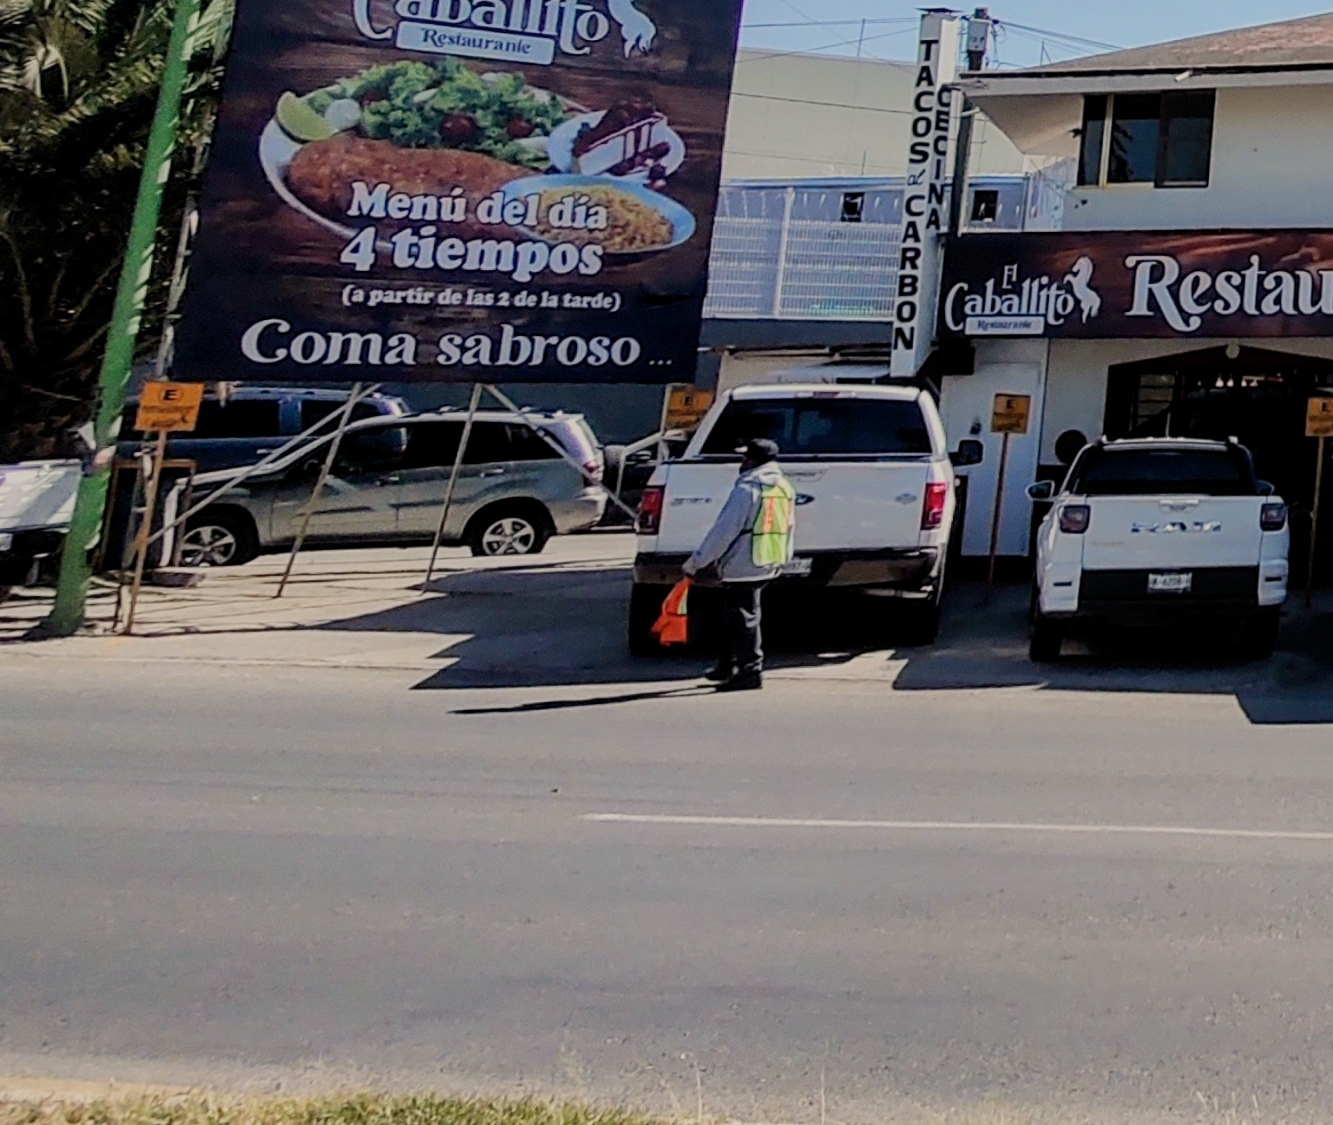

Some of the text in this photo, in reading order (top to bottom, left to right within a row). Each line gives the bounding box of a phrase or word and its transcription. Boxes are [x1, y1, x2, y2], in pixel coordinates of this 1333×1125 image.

[420, 27, 531, 54] Restaurante
[909, 39, 938, 164] TACOS
[926, 84, 951, 231] CECINA
[347, 181, 607, 230] Menú del día
[340, 226, 604, 283] 4 tiempos
[893, 194, 926, 351] CARBON
[342, 285, 621, 312] (a partir de las 2 de la tarde)
[945, 276, 1075, 331] Caballito
[240, 319, 416, 365] Coma
[163, 389, 178, 401] E
